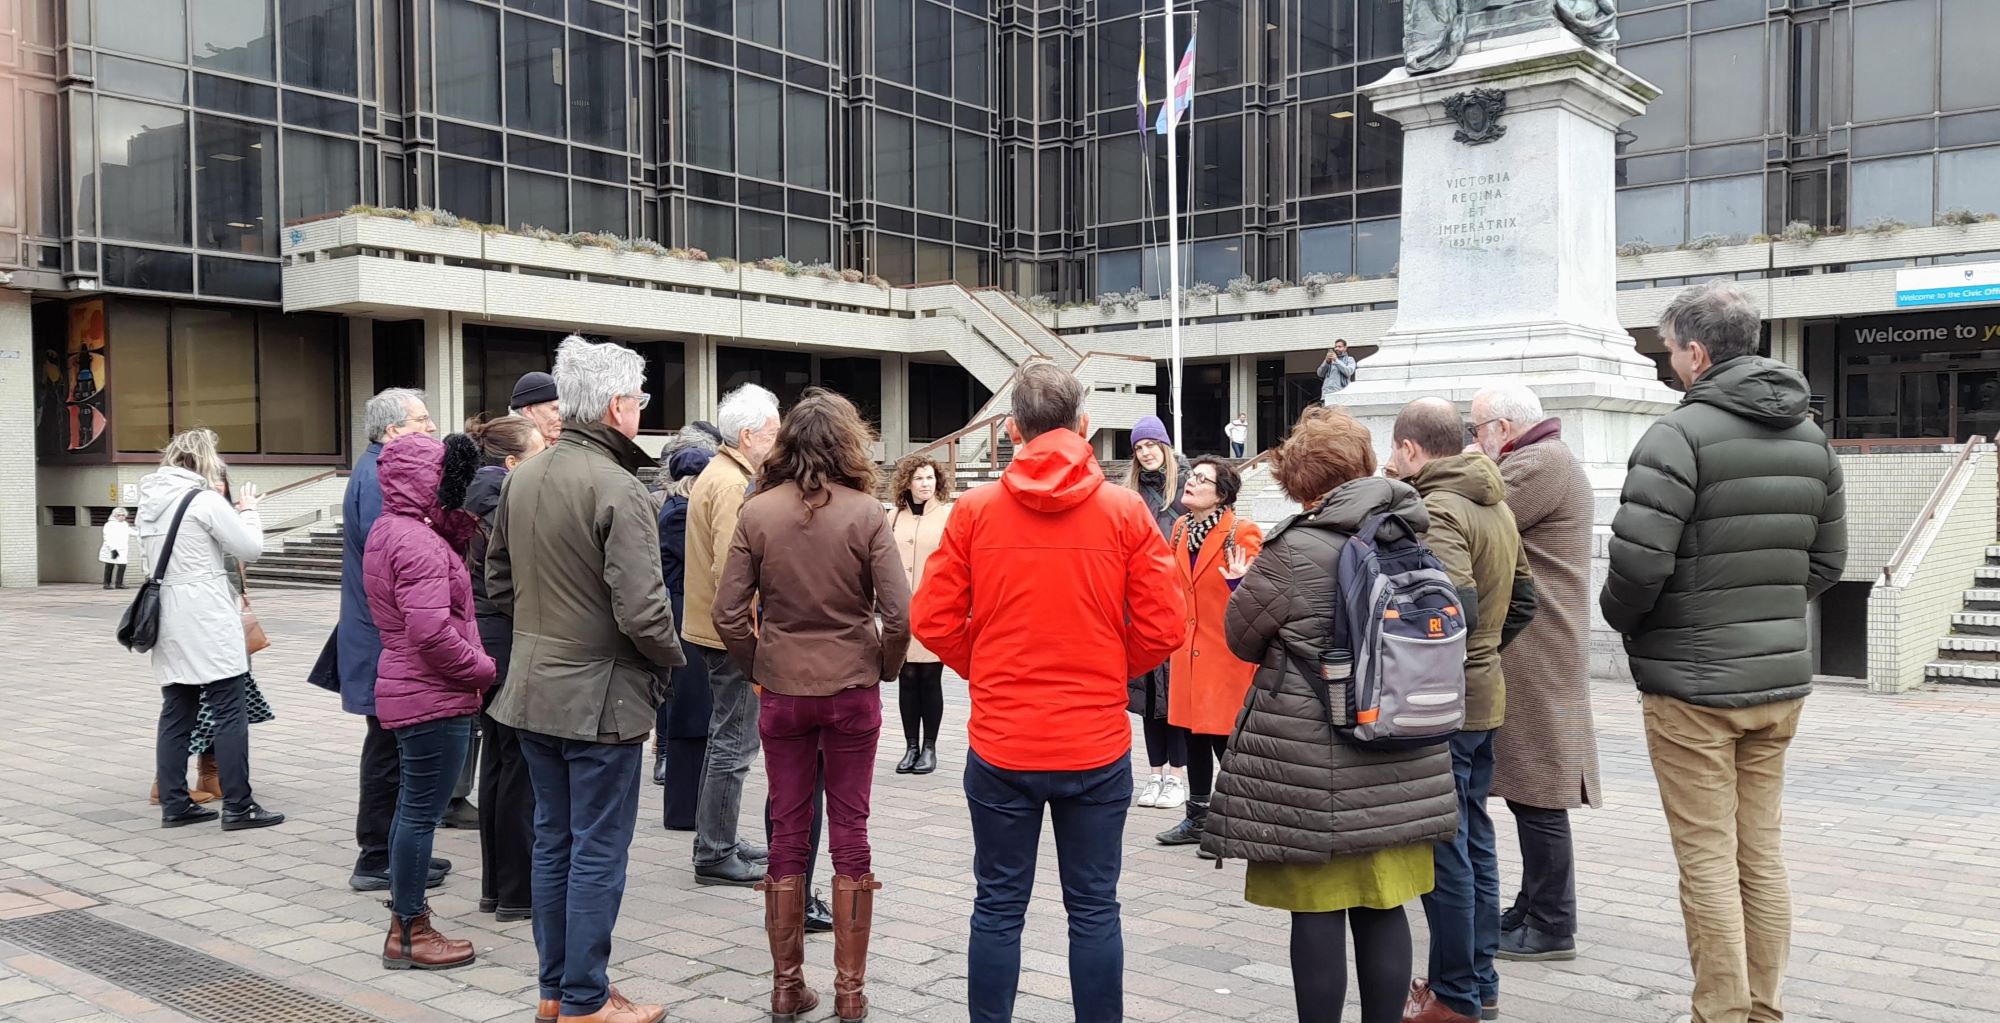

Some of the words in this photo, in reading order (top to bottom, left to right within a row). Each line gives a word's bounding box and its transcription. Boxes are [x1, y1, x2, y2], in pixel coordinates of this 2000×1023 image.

[1446, 171, 1511, 189] VICTORIA
[1469, 206, 1486, 217] ET
[1439, 217, 1518, 236] IMPERATRIX
[1900, 293, 1935, 302] Welcome
[1948, 290, 1961, 298] the
[1963, 288, 1983, 297] Civic
[1854, 326, 1949, 344] Welcome
[1954, 324, 1977, 339] to
